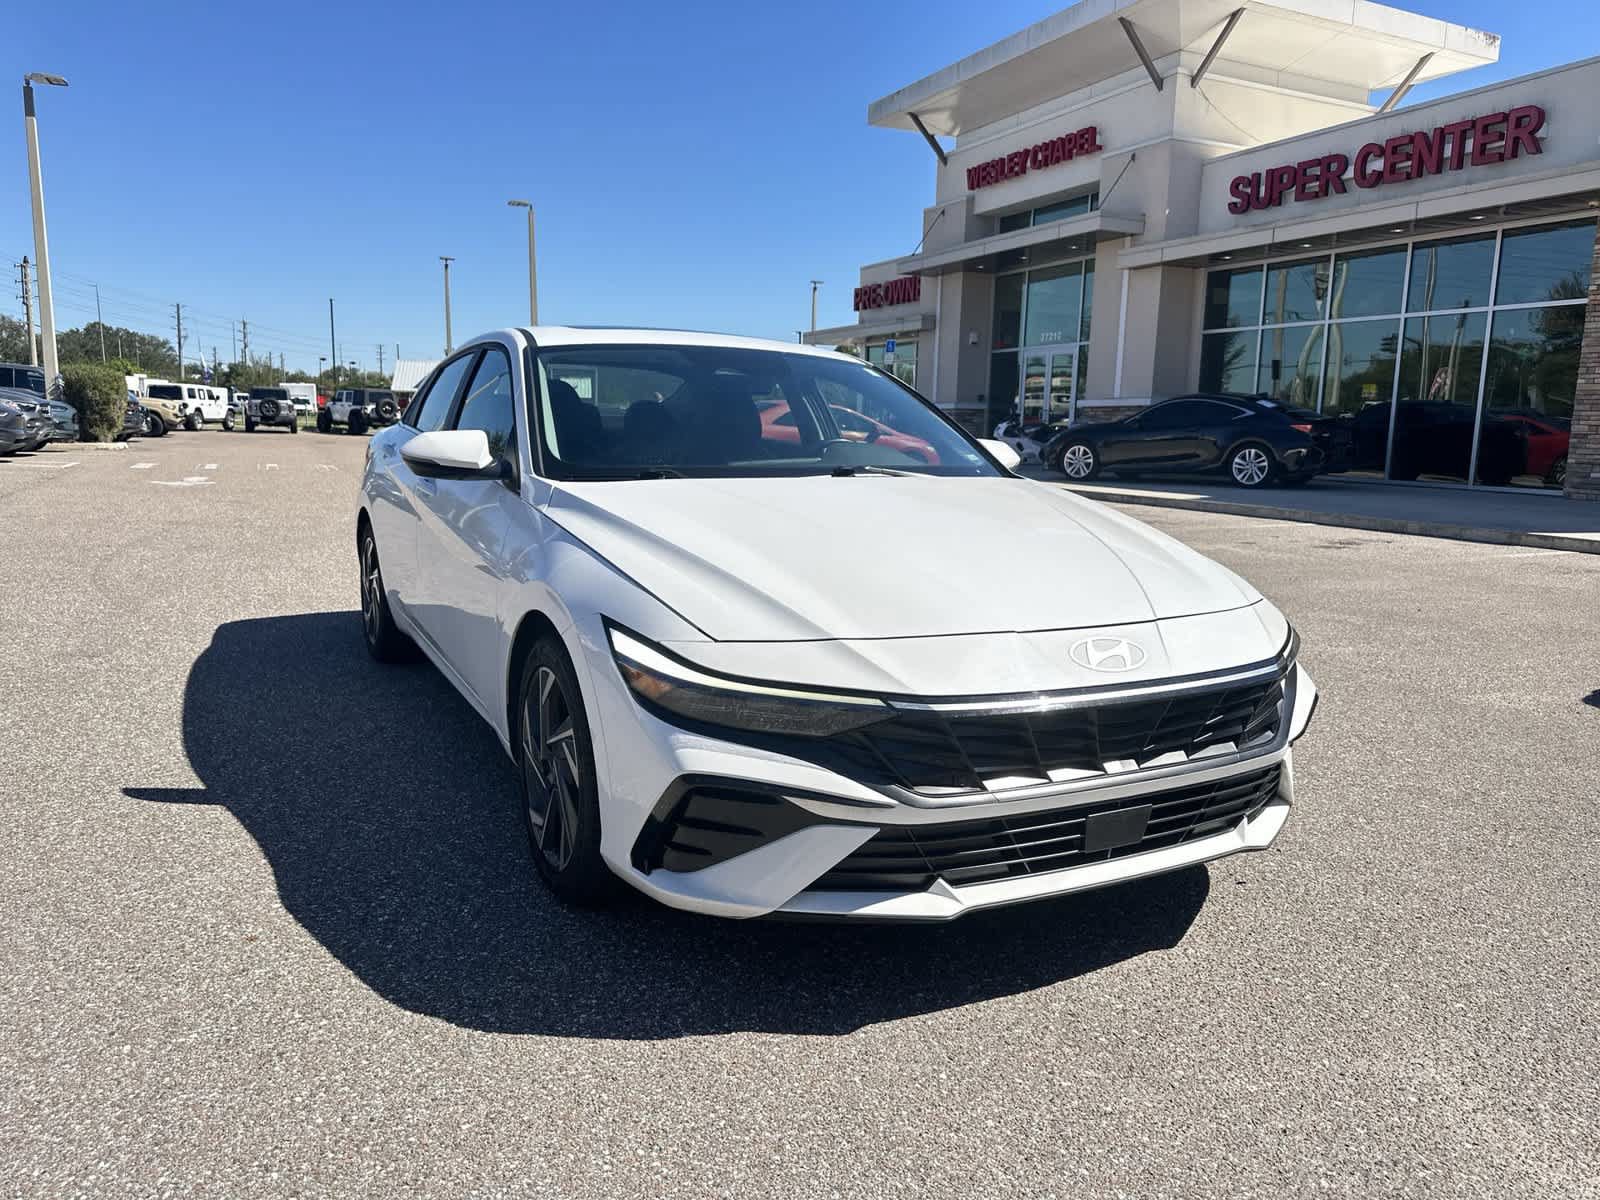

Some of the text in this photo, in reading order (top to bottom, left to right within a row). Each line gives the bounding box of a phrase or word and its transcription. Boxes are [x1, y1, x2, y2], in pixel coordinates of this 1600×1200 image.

[966, 126, 1103, 191] WESLEY CHAPEL
[1228, 104, 1546, 215] SUPER CENTER
